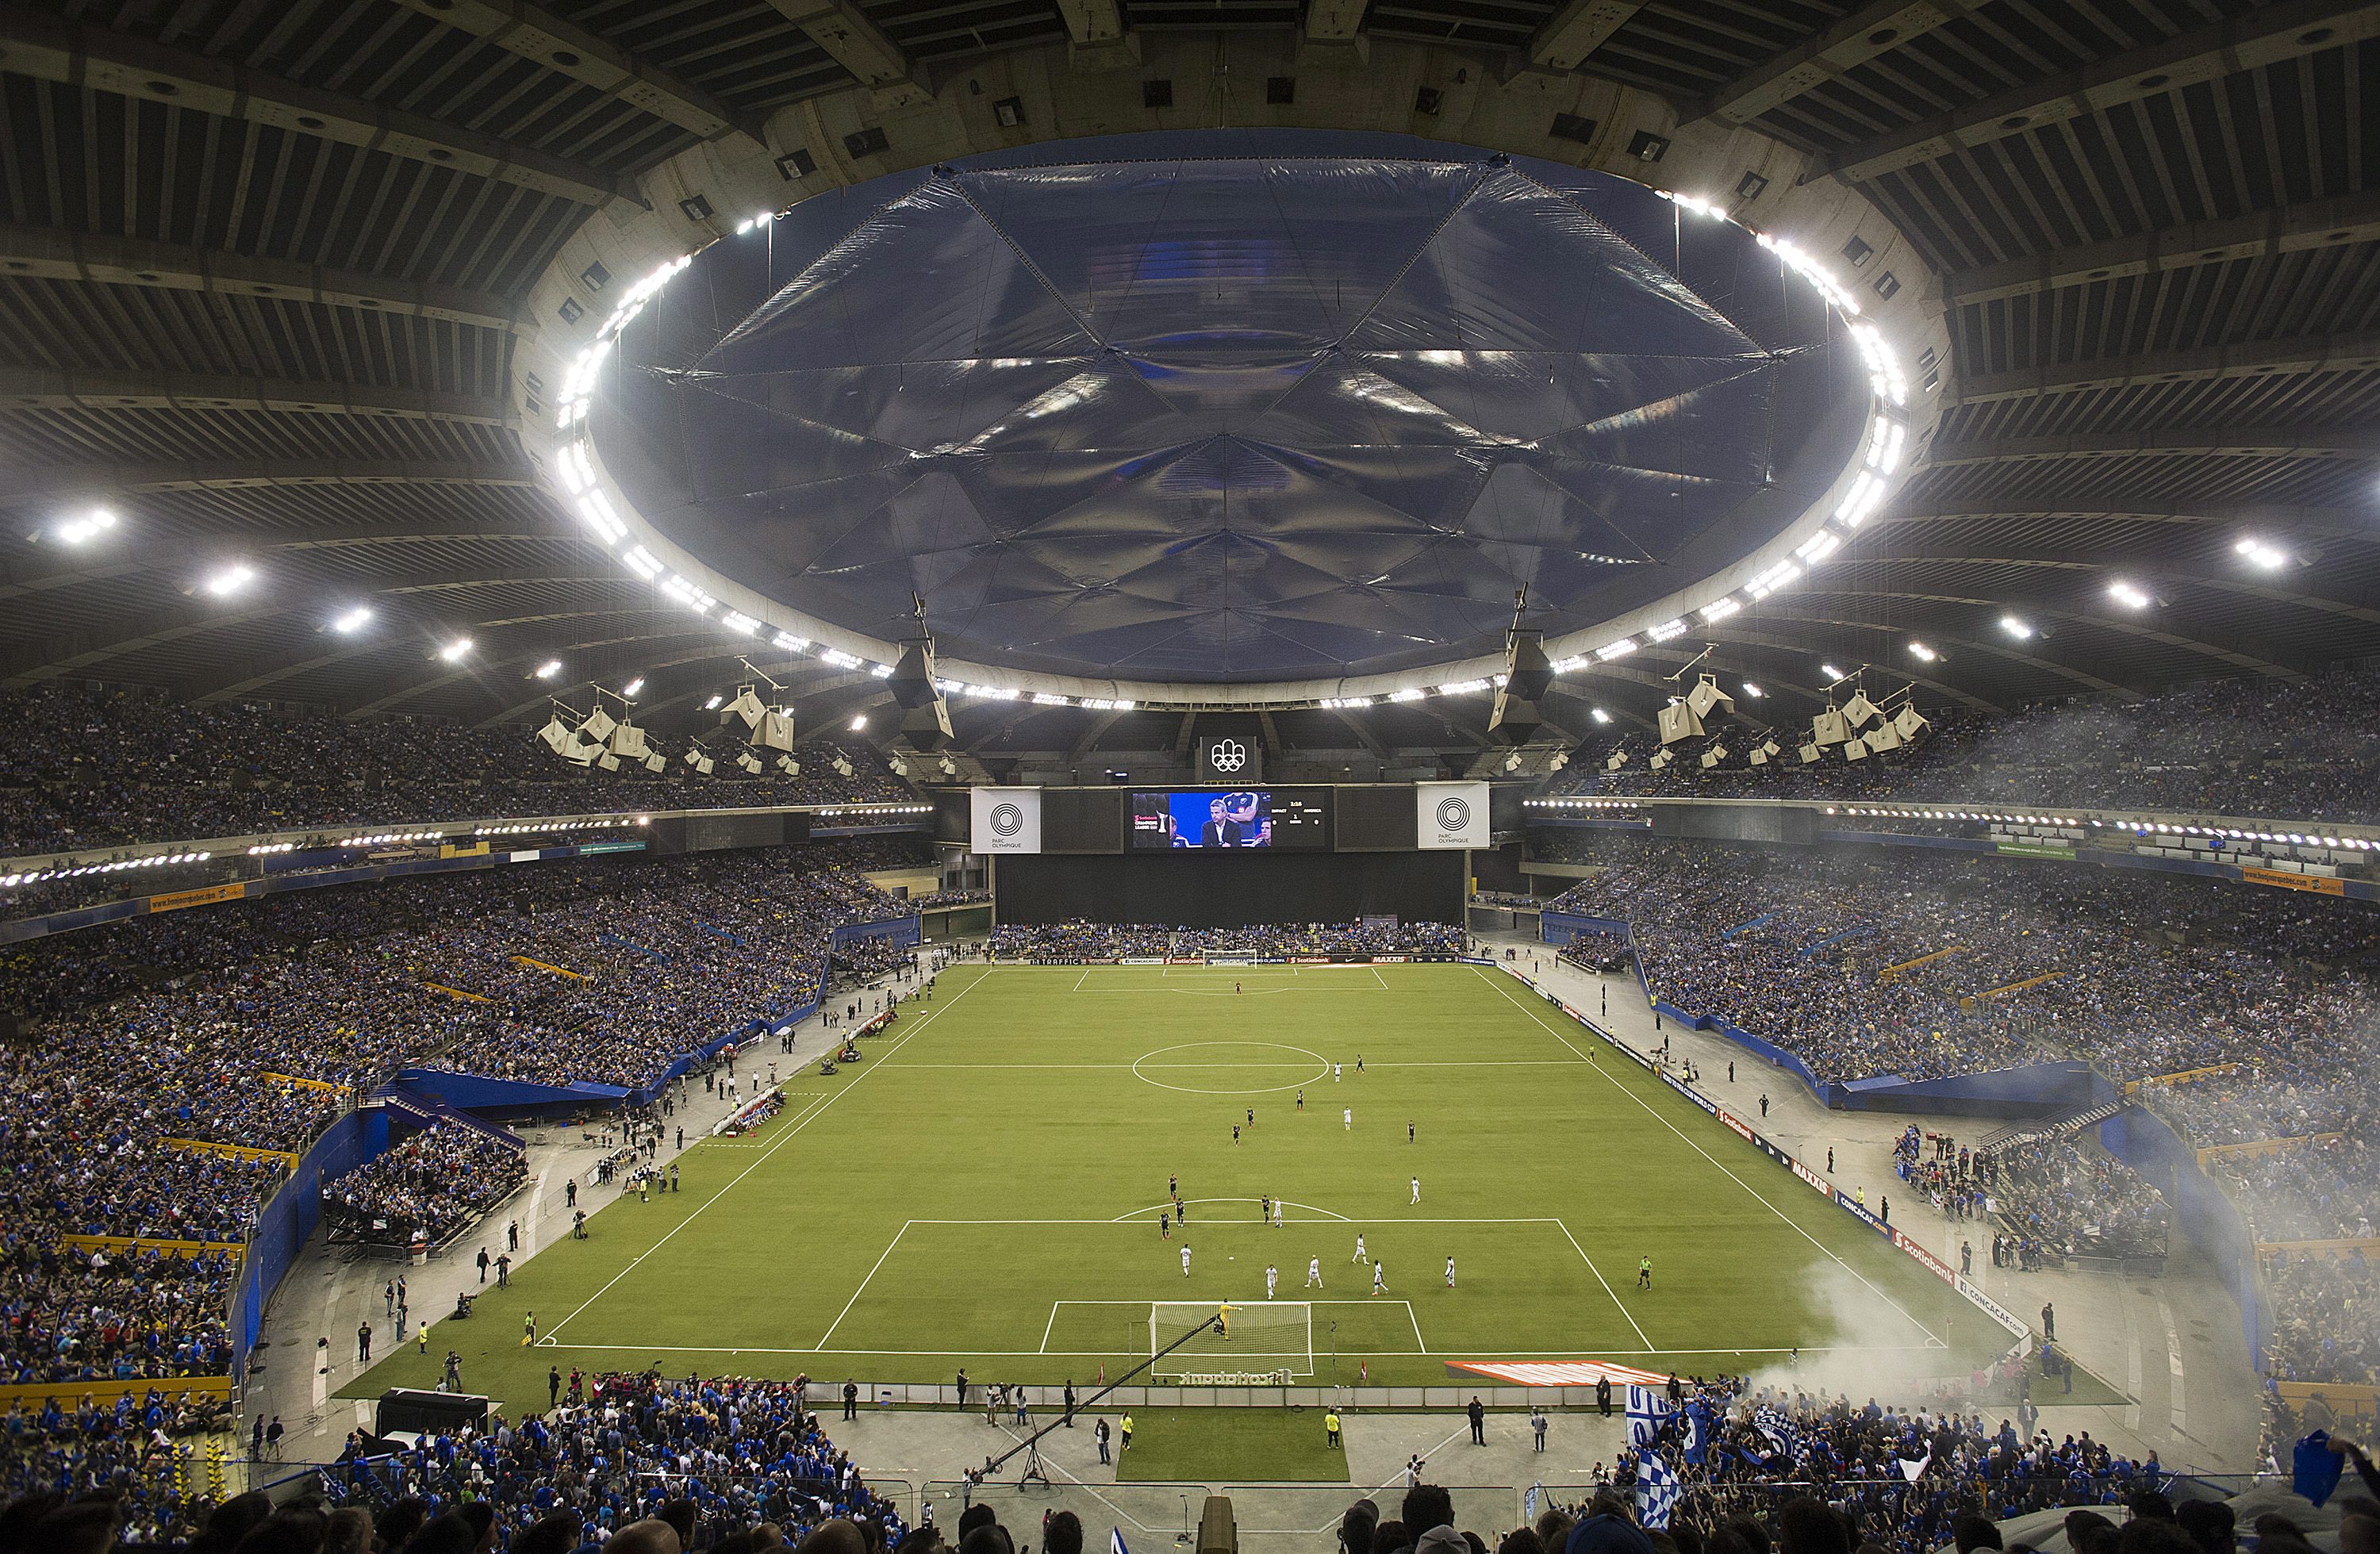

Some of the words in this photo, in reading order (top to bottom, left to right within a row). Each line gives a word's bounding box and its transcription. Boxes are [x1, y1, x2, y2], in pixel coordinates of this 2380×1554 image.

[1684, 1086, 1694, 1099] CLUB
[1693, 1092, 1707, 1108] WORLD
[1706, 1102, 1716, 1114] CUP
[1724, 1113, 1752, 1141] Scotiabank
[1792, 1161, 1828, 1195] MAXXIS
[1841, 1197, 1888, 1235] CONCACAF.com
[1904, 1241, 1953, 1284] Scotiabank
